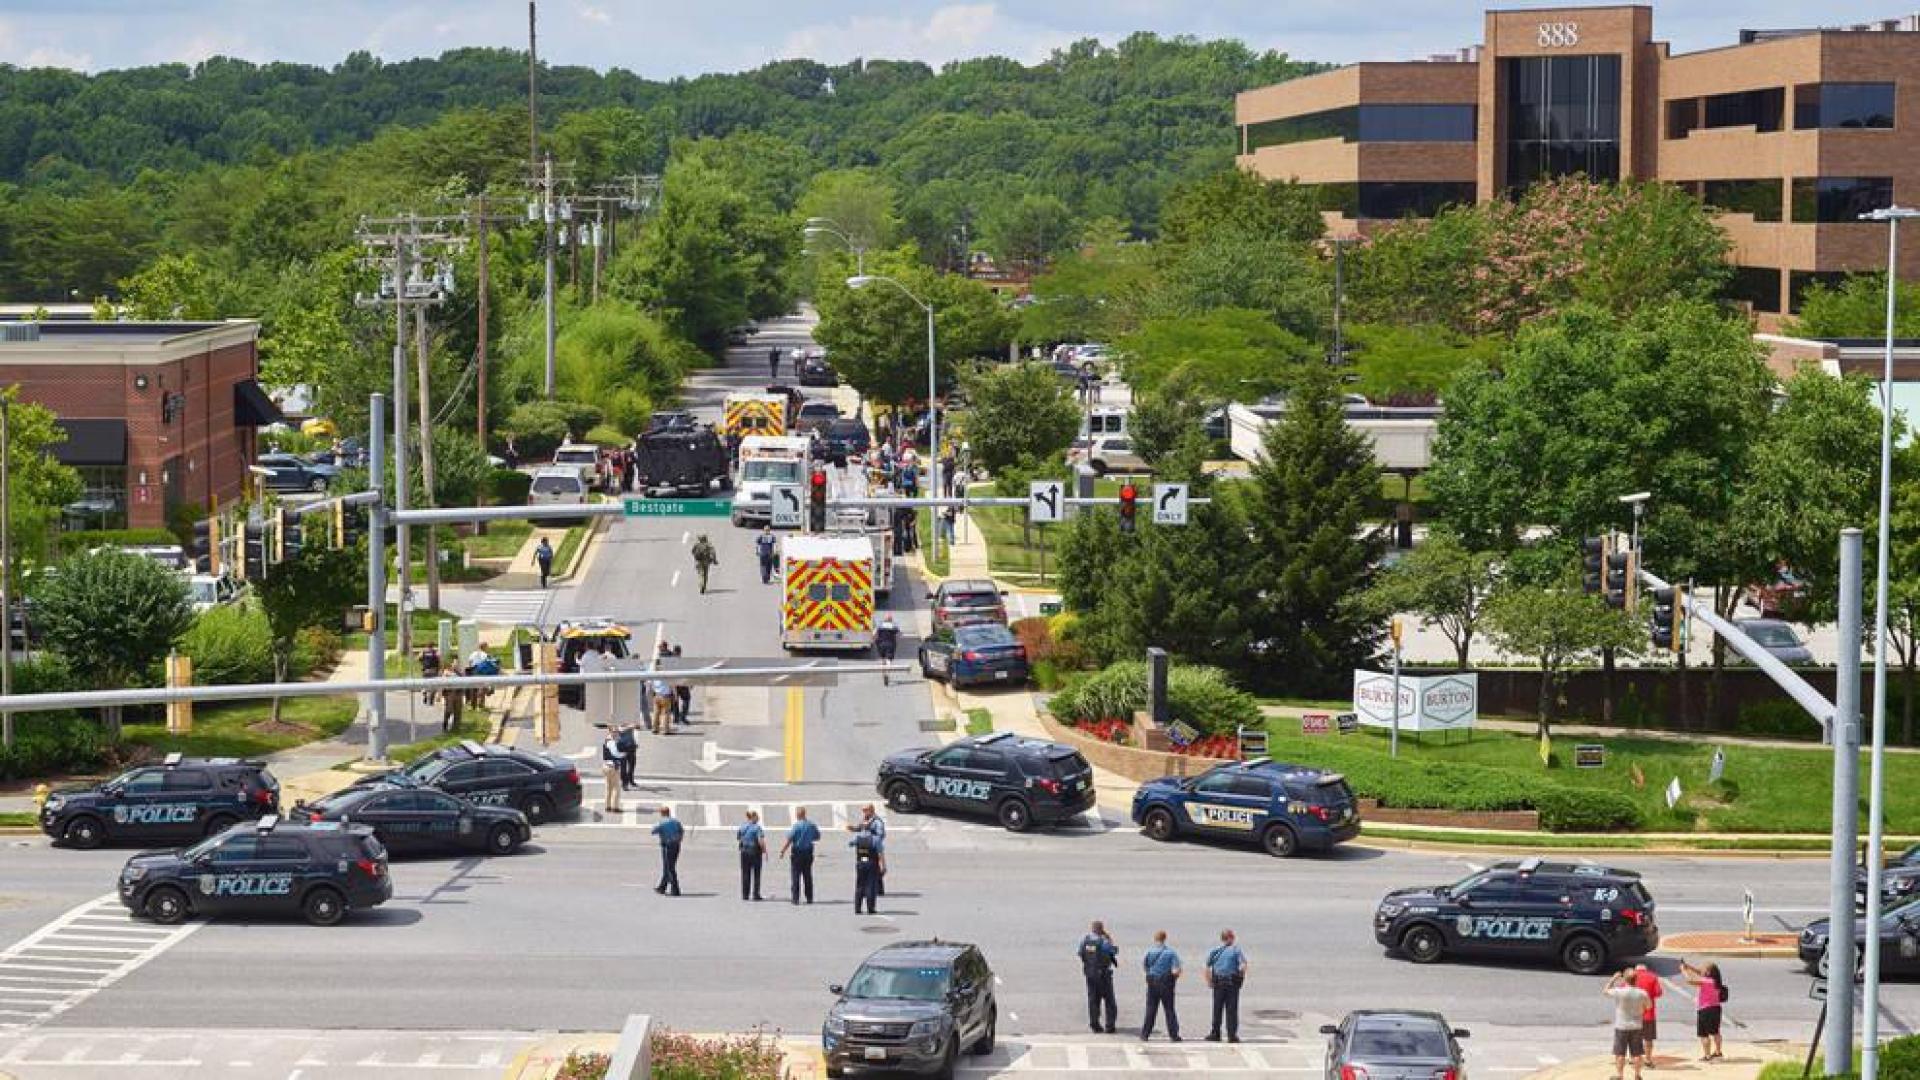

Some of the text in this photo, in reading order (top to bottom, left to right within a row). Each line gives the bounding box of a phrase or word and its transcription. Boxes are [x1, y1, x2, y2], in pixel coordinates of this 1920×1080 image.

[1538, 22, 1578, 47] 888
[632, 502, 684, 515] Bestgate
[776, 513, 799, 522] ONLY
[1158, 513, 1182, 521] ONLY
[1426, 691, 1471, 706] BURTON
[935, 779, 990, 799] POLICE
[128, 806, 197, 823] POLICE
[1206, 808, 1252, 823] POLICE
[216, 878, 291, 895] POLICE
[1594, 888, 1618, 902] K-9
[1472, 919, 1552, 939] POLICE
